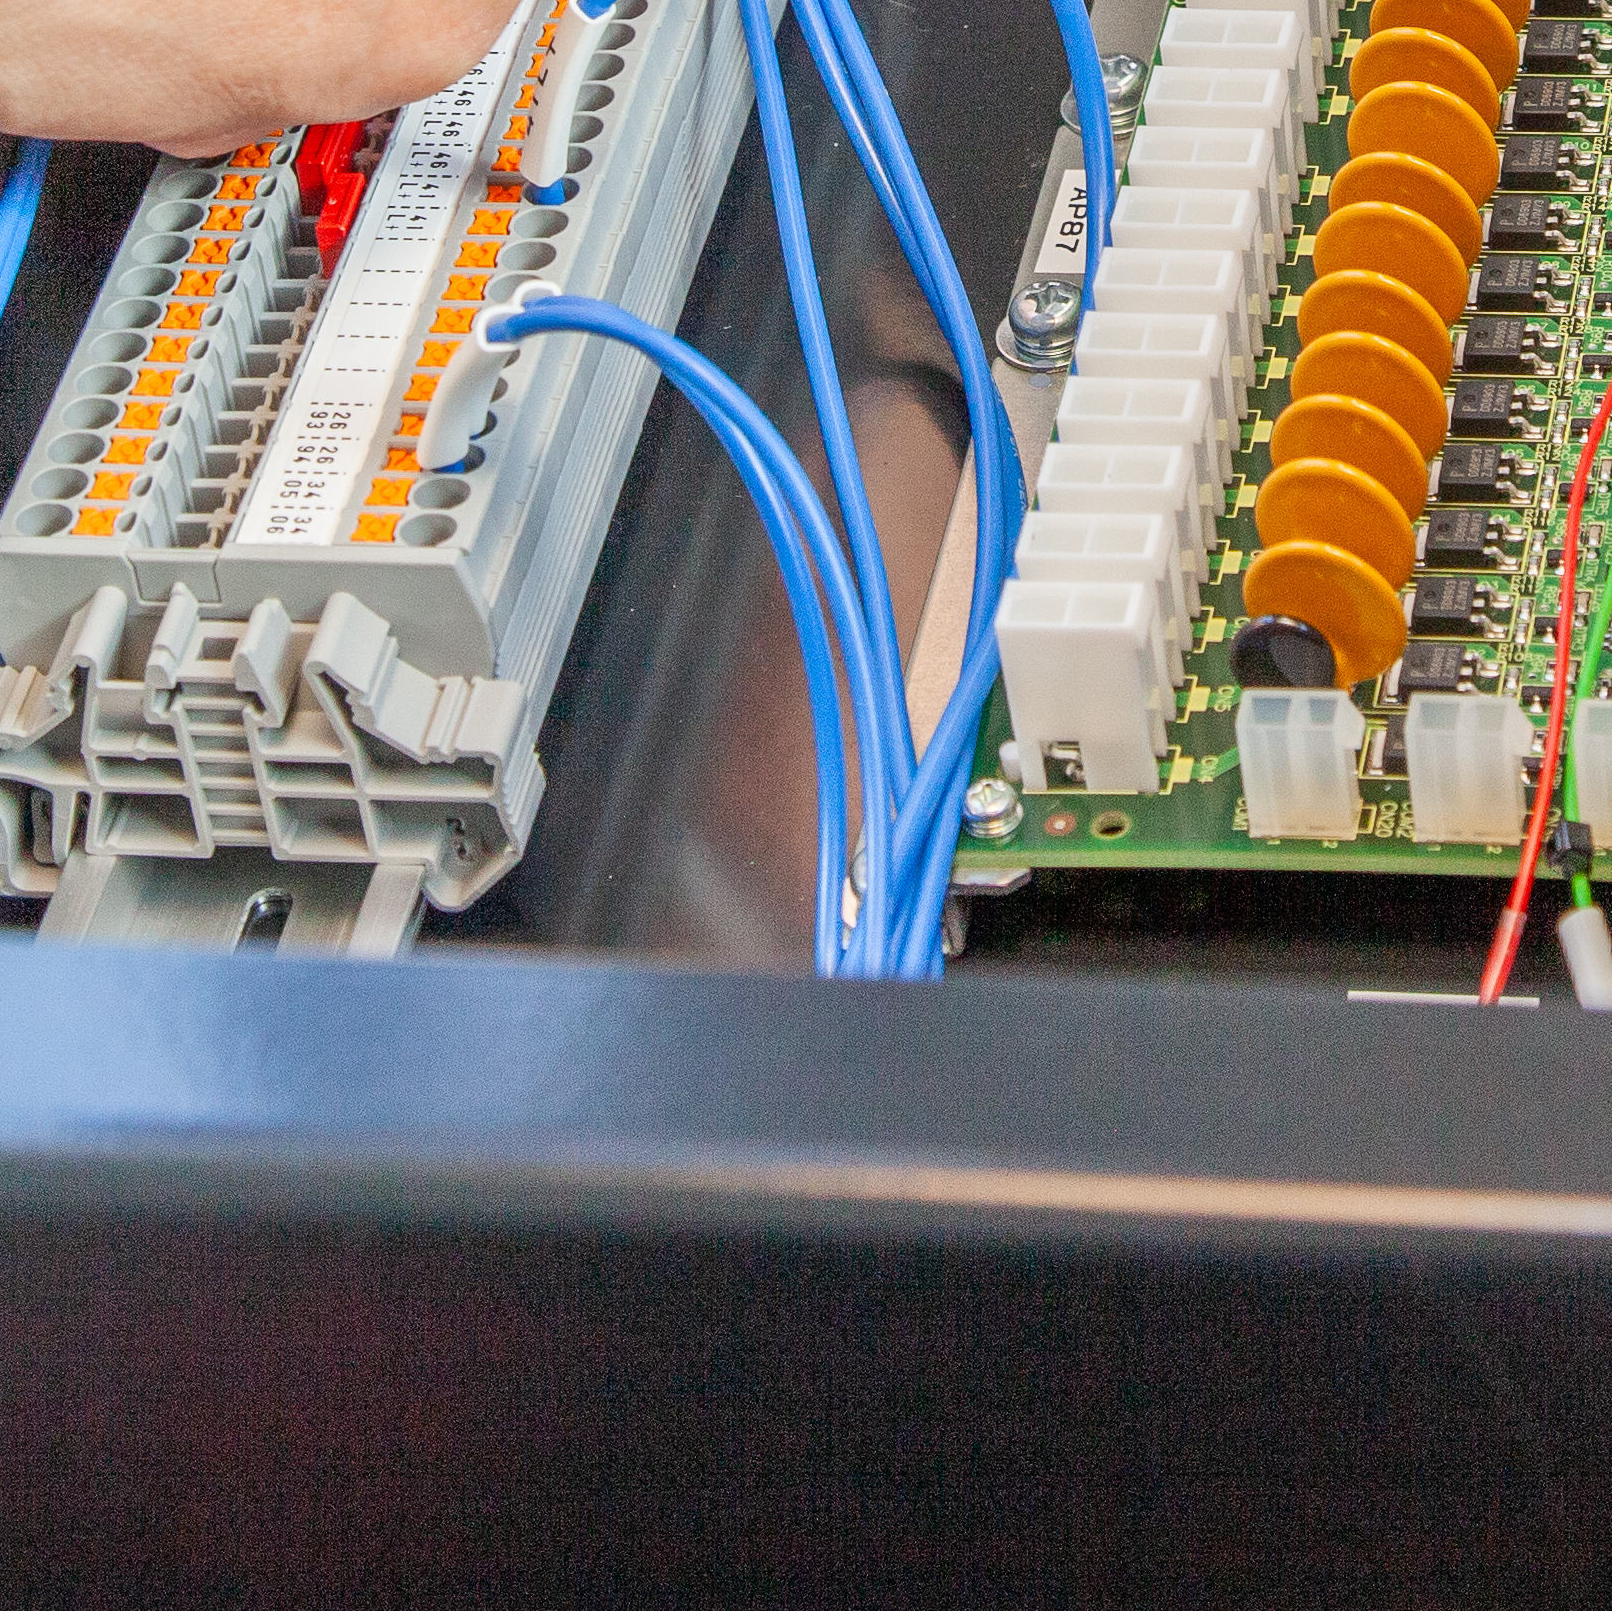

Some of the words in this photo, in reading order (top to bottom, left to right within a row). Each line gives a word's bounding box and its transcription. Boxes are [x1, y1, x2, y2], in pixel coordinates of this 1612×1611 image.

[454, 90, 472, 106] 46
[424, 121, 442, 136] L+
[442, 121, 463, 137] 46
[410, 152, 430, 168] L+
[430, 152, 451, 168] 46
[398, 183, 418, 198] L+
[419, 184, 439, 198] 41
[388, 215, 407, 231] L+
[407, 215, 427, 229] 41
[1056, 187, 1087, 253] AP87
[1590, 327, 1604, 344] R99
[1578, 390, 1592, 407] R98
[306, 411, 328, 429] 93
[330, 412, 351, 429] 26
[293, 446, 315, 463] 94
[316, 446, 338, 464] 26
[280, 480, 302, 498] 05
[304, 481, 325, 498] 34
[1596, 493, 1610, 515] DTR5
[267, 516, 289, 534] 06
[290, 517, 312, 534] 34
[1585, 559, 1599, 582] DTR4
[1214, 685, 1235, 712] CN5
[1199, 755, 1218, 783] CN4
[1376, 801, 1398, 838] CN20
